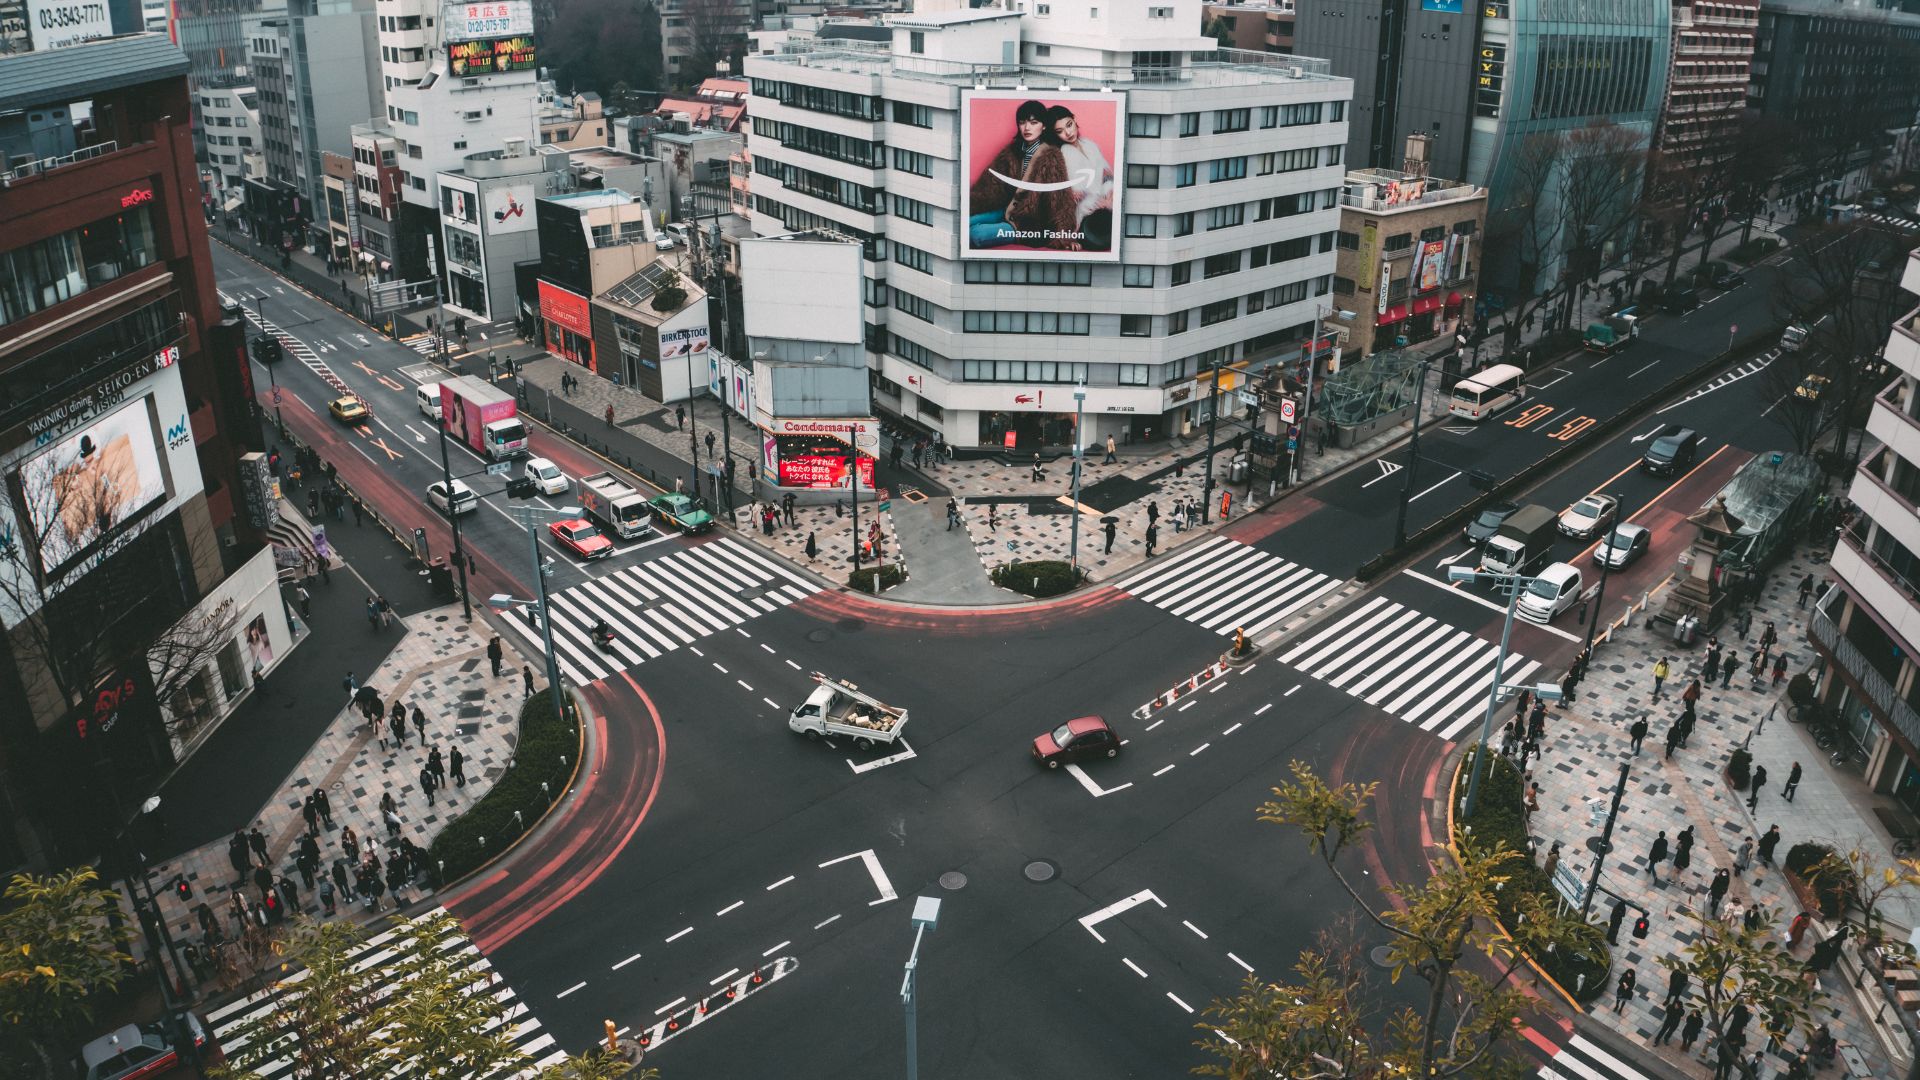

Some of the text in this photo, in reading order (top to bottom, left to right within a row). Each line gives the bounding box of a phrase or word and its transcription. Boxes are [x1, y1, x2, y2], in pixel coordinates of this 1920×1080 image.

[40, 4, 105, 29] 03-3543-7771
[467, 18, 510, 32] 0120-075-787
[1479, 49, 1495, 86] GYM
[997, 228, 1085, 240] Amazon Fashion
[661, 327, 708, 343] BIRKENSTOCK
[27, 347, 179, 435] YAKINIKU dining SEIKO-EN 焼肉
[56, 391, 125, 435] マイナビ Vision
[1504, 404, 1554, 428] 50
[784, 421, 866, 433] Condomania
[1547, 416, 1596, 440] 50
[169, 434, 190, 450] マイナビ
[781, 458, 837, 466] トレーニングすれば、
[789, 473, 833, 481] トクイになれる。
[202, 596, 234, 628] PANDORA
